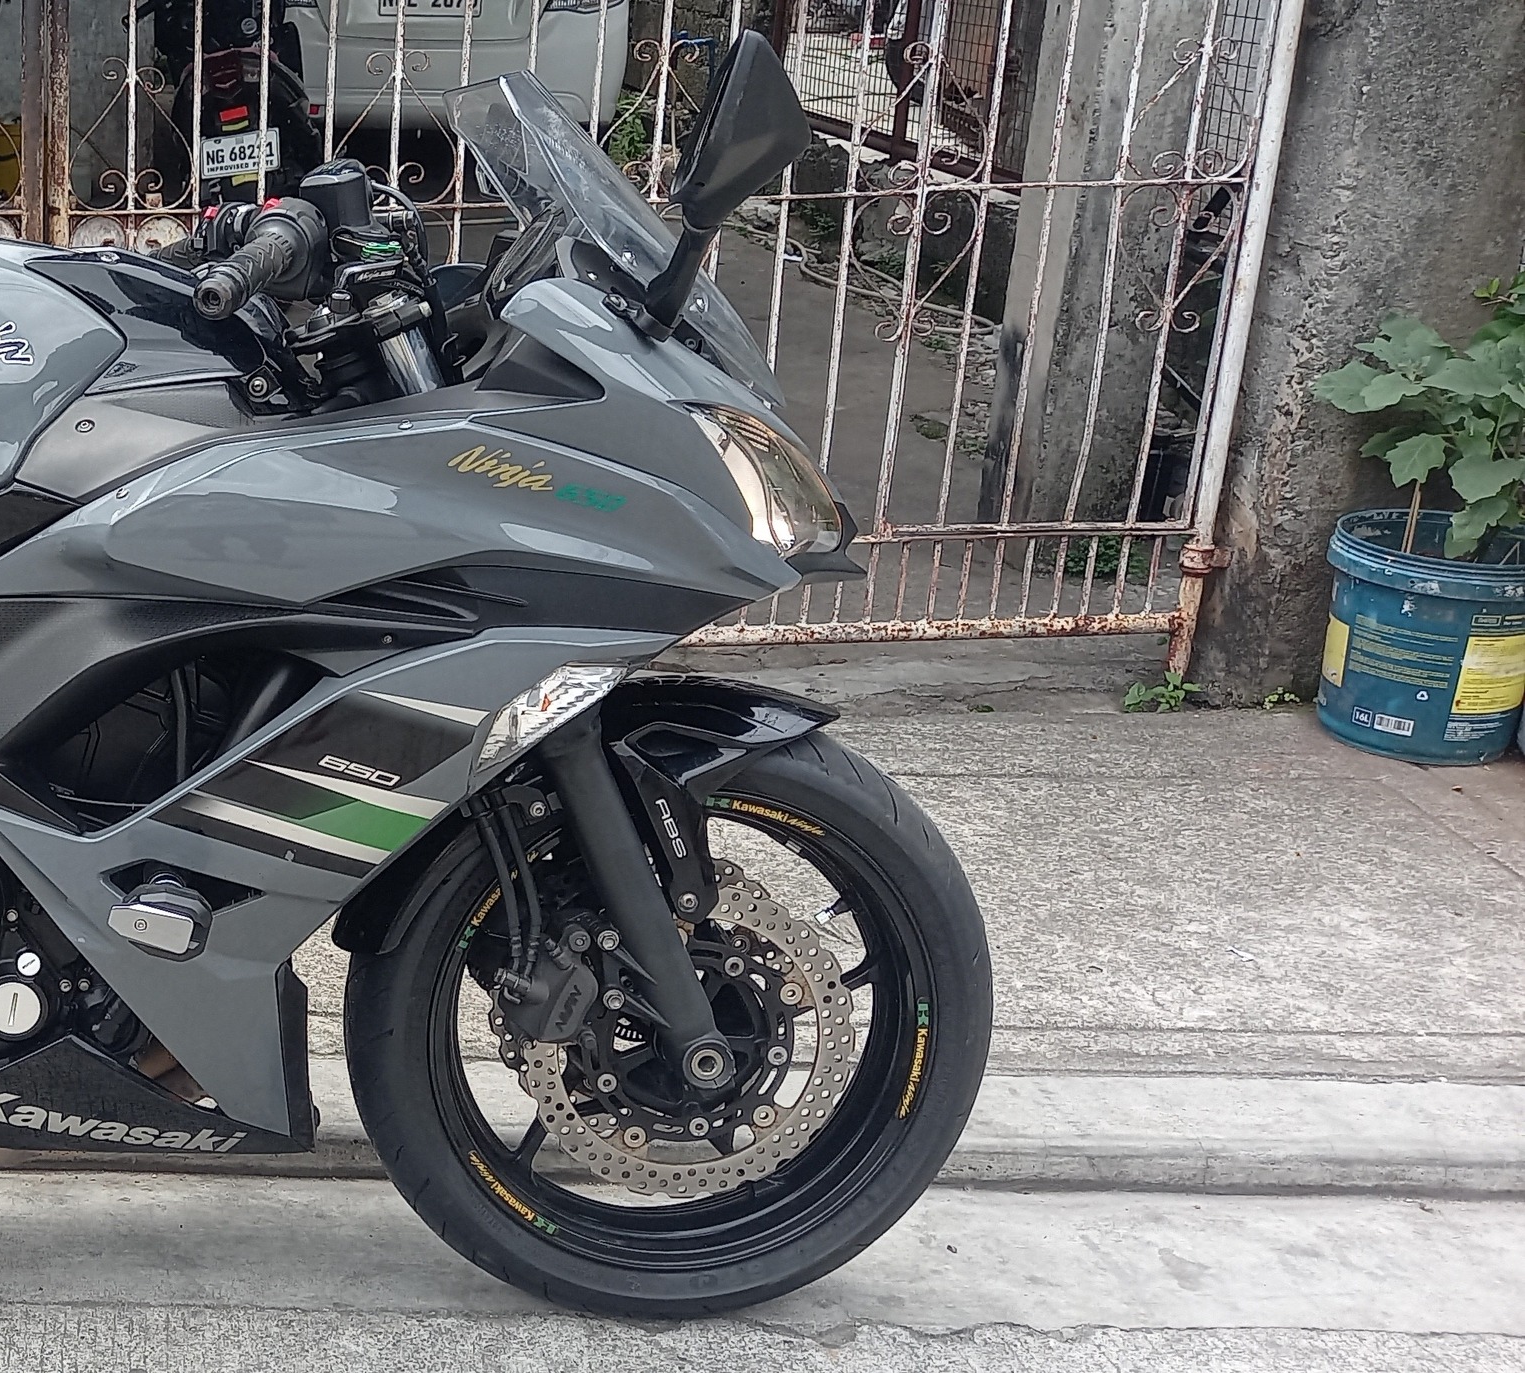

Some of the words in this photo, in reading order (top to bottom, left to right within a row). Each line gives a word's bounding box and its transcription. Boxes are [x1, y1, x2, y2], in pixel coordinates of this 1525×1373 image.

[206, 149, 225, 166] NG
[207, 162, 249, 173] IMPROVISED
[448, 445, 553, 491] Ninja
[317, 754, 401, 787] 650
[655, 799, 686, 858] ABS
[732, 799, 788, 823] Kawasaki
[470, 885, 502, 927] Kawasa
[909, 1028, 928, 1083] Kawasaki
[490, 1181, 535, 1221] Kawasaki
